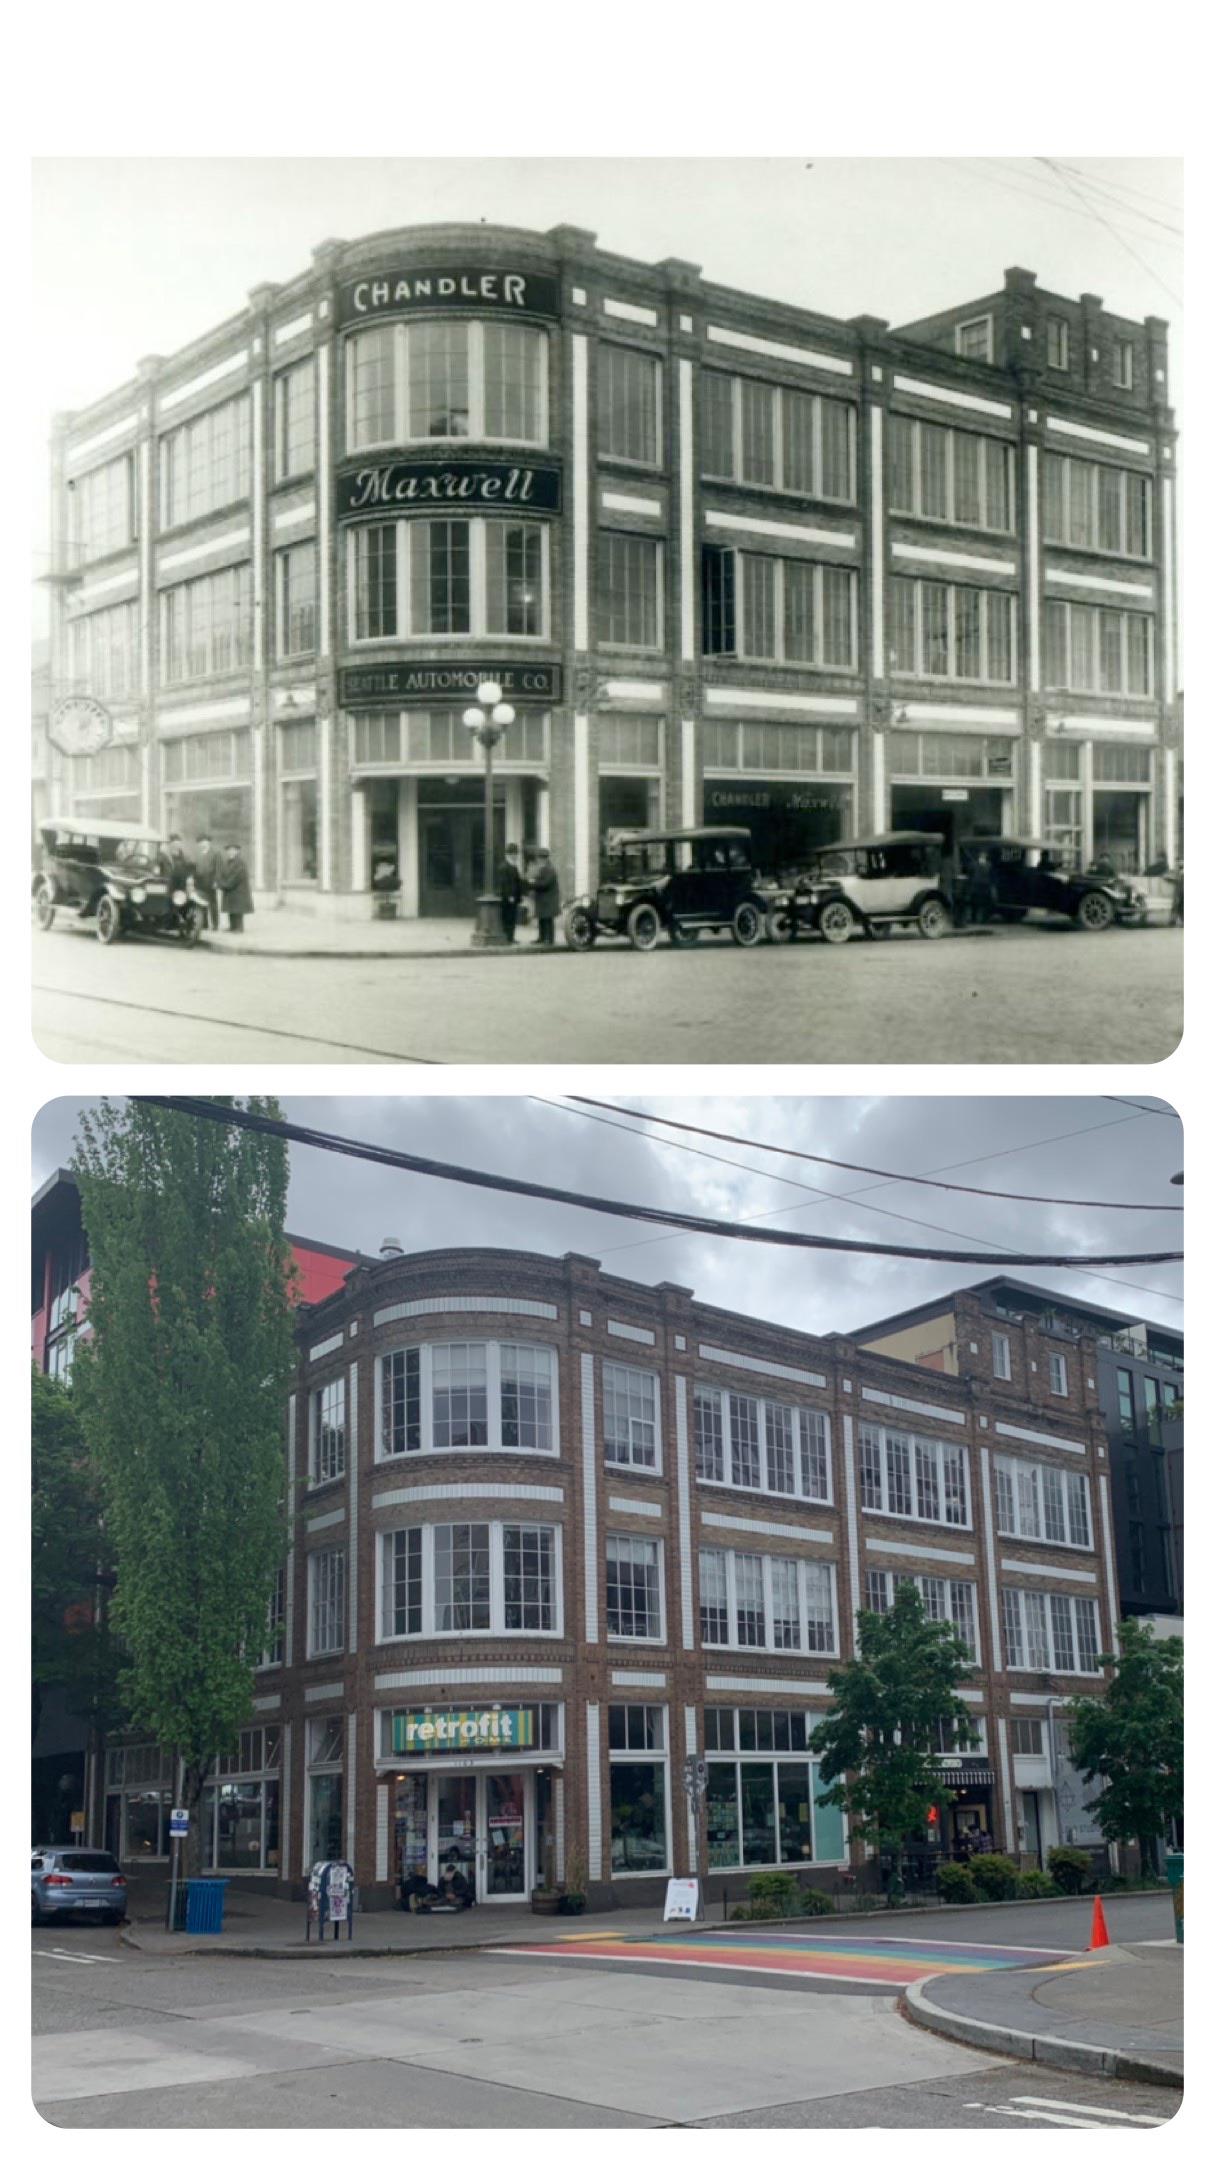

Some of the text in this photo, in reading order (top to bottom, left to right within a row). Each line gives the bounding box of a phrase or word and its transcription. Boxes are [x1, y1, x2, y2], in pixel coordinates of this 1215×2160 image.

[353, 275, 526, 312] CHANDLER
[350, 466, 535, 507] Maxwell
[406, 1712, 513, 1741] retrofit
